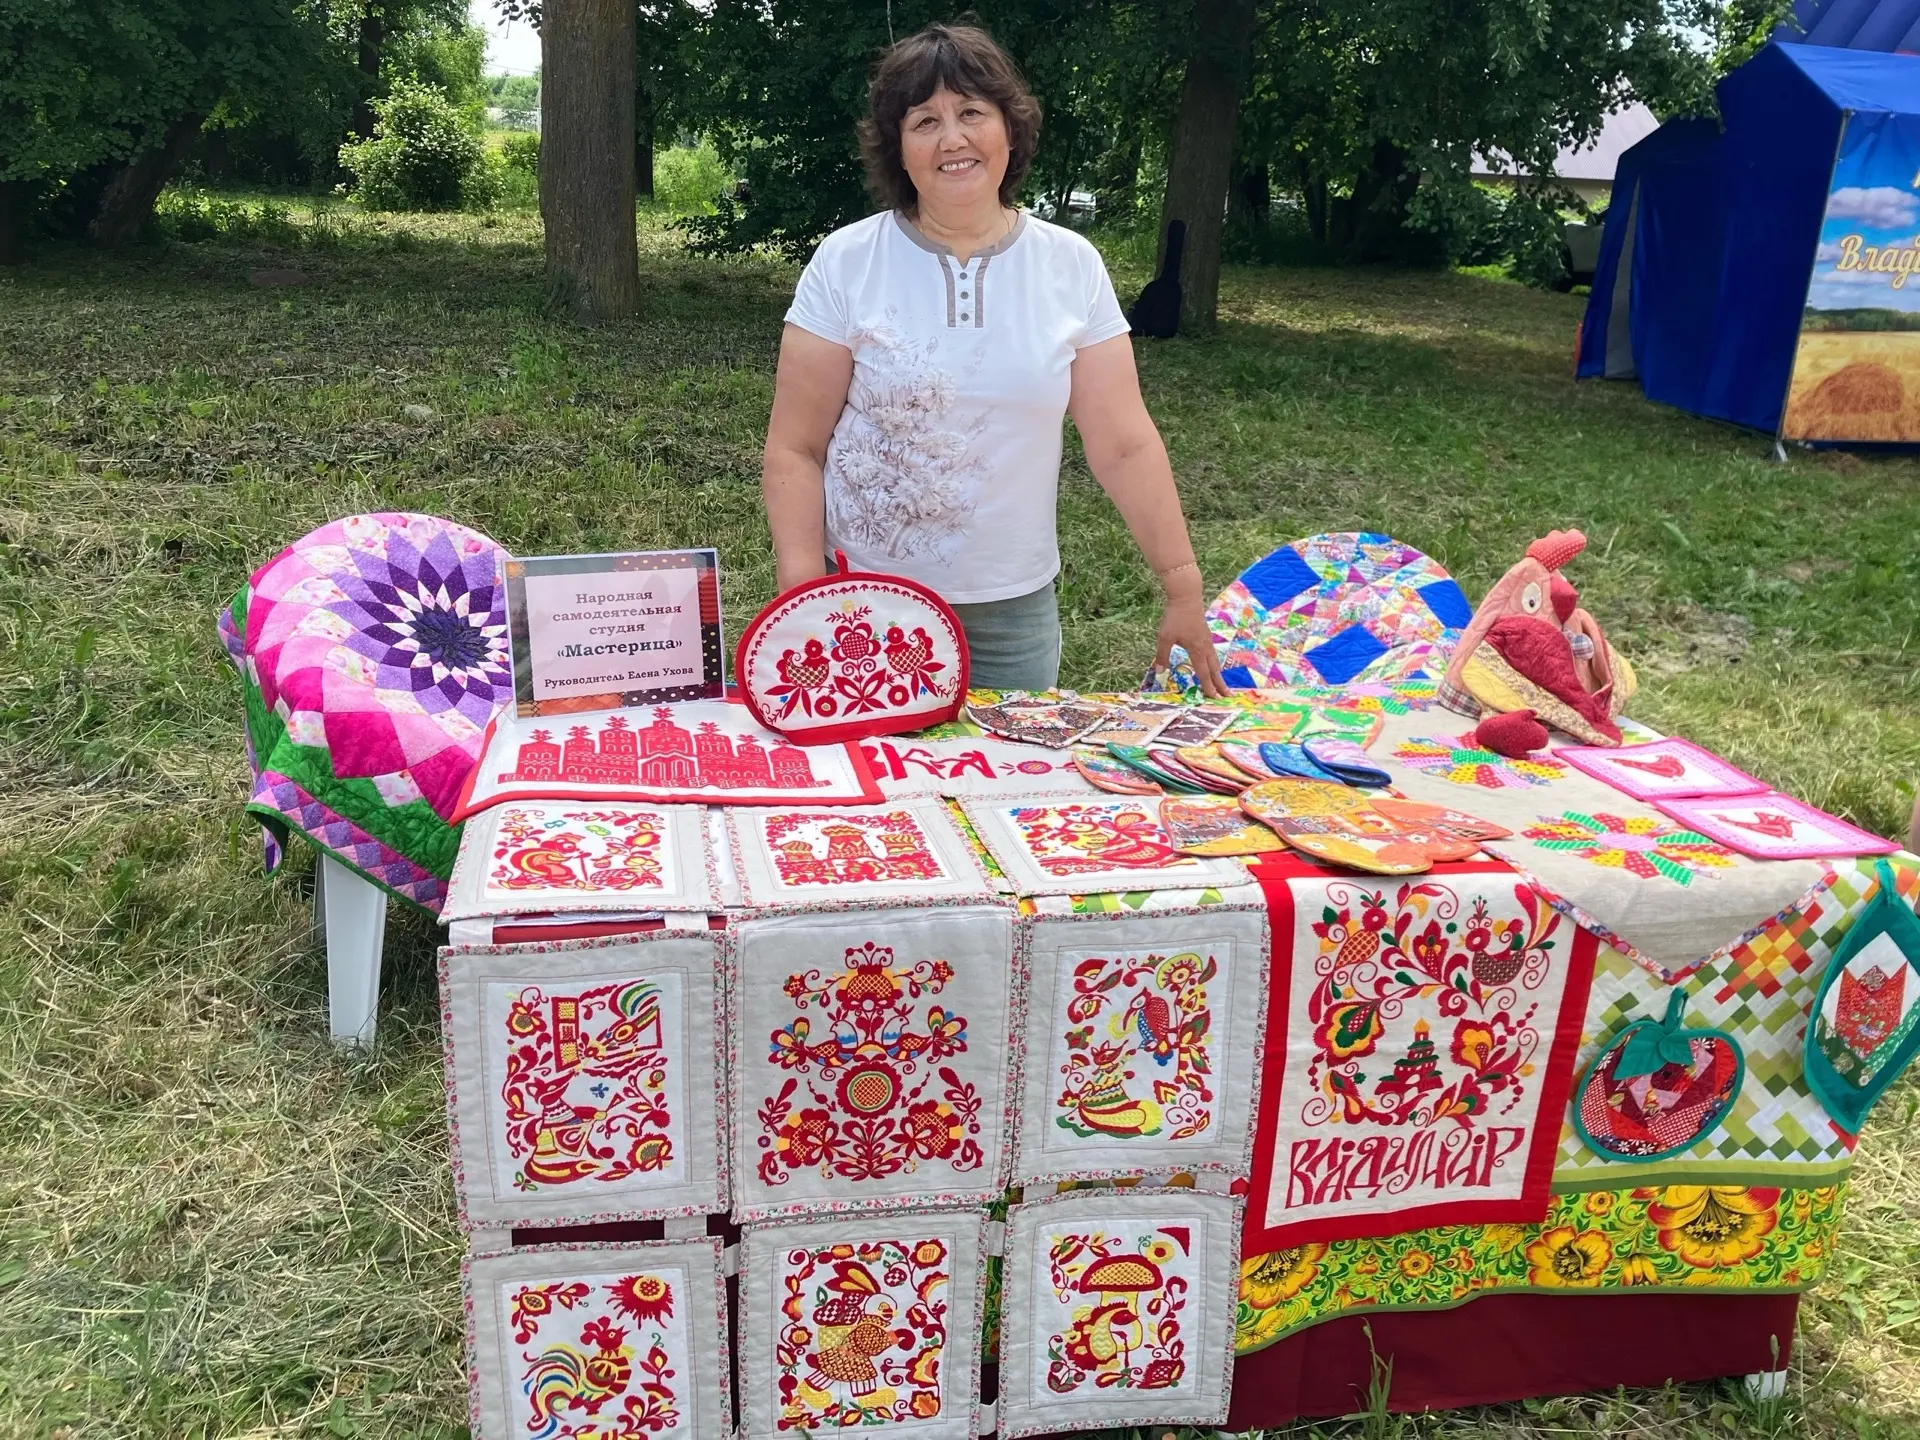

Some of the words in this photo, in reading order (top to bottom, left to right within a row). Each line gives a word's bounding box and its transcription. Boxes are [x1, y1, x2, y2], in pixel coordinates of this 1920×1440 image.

[575, 591, 653, 606] Народная
[552, 605, 682, 622] самодеятельная
[589, 623, 646, 636] студия
[557, 638, 683, 658] «Мастерица»
[544, 673, 625, 688] Руководитель
[627, 669, 660, 680] Елена
[662, 666, 694, 677] Ухова
